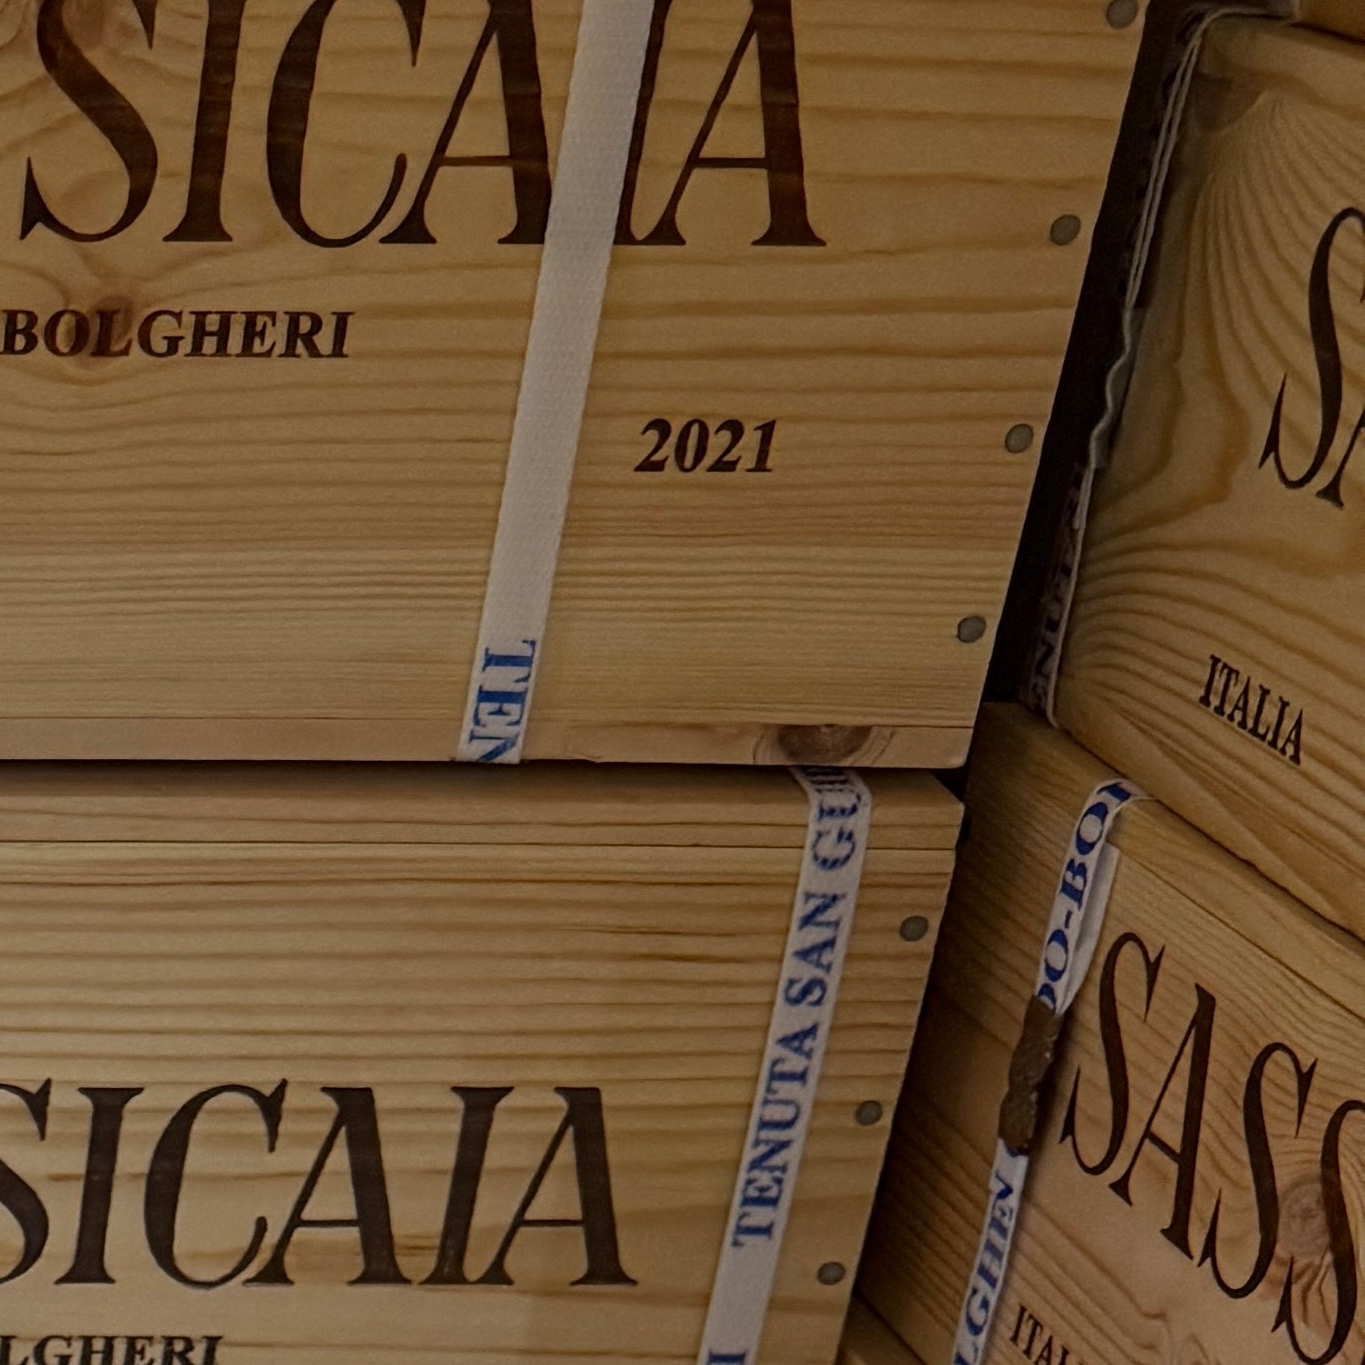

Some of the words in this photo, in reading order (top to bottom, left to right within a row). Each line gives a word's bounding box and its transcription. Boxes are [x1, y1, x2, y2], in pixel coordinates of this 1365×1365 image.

[0, 308, 355, 359] BOLGHERI
[633, 418, 778, 473] 2021
[1198, 654, 1305, 766] ITALIA
[732, 1022, 818, 1248] TENUTA
[784, 891, 847, 1008] SAN
